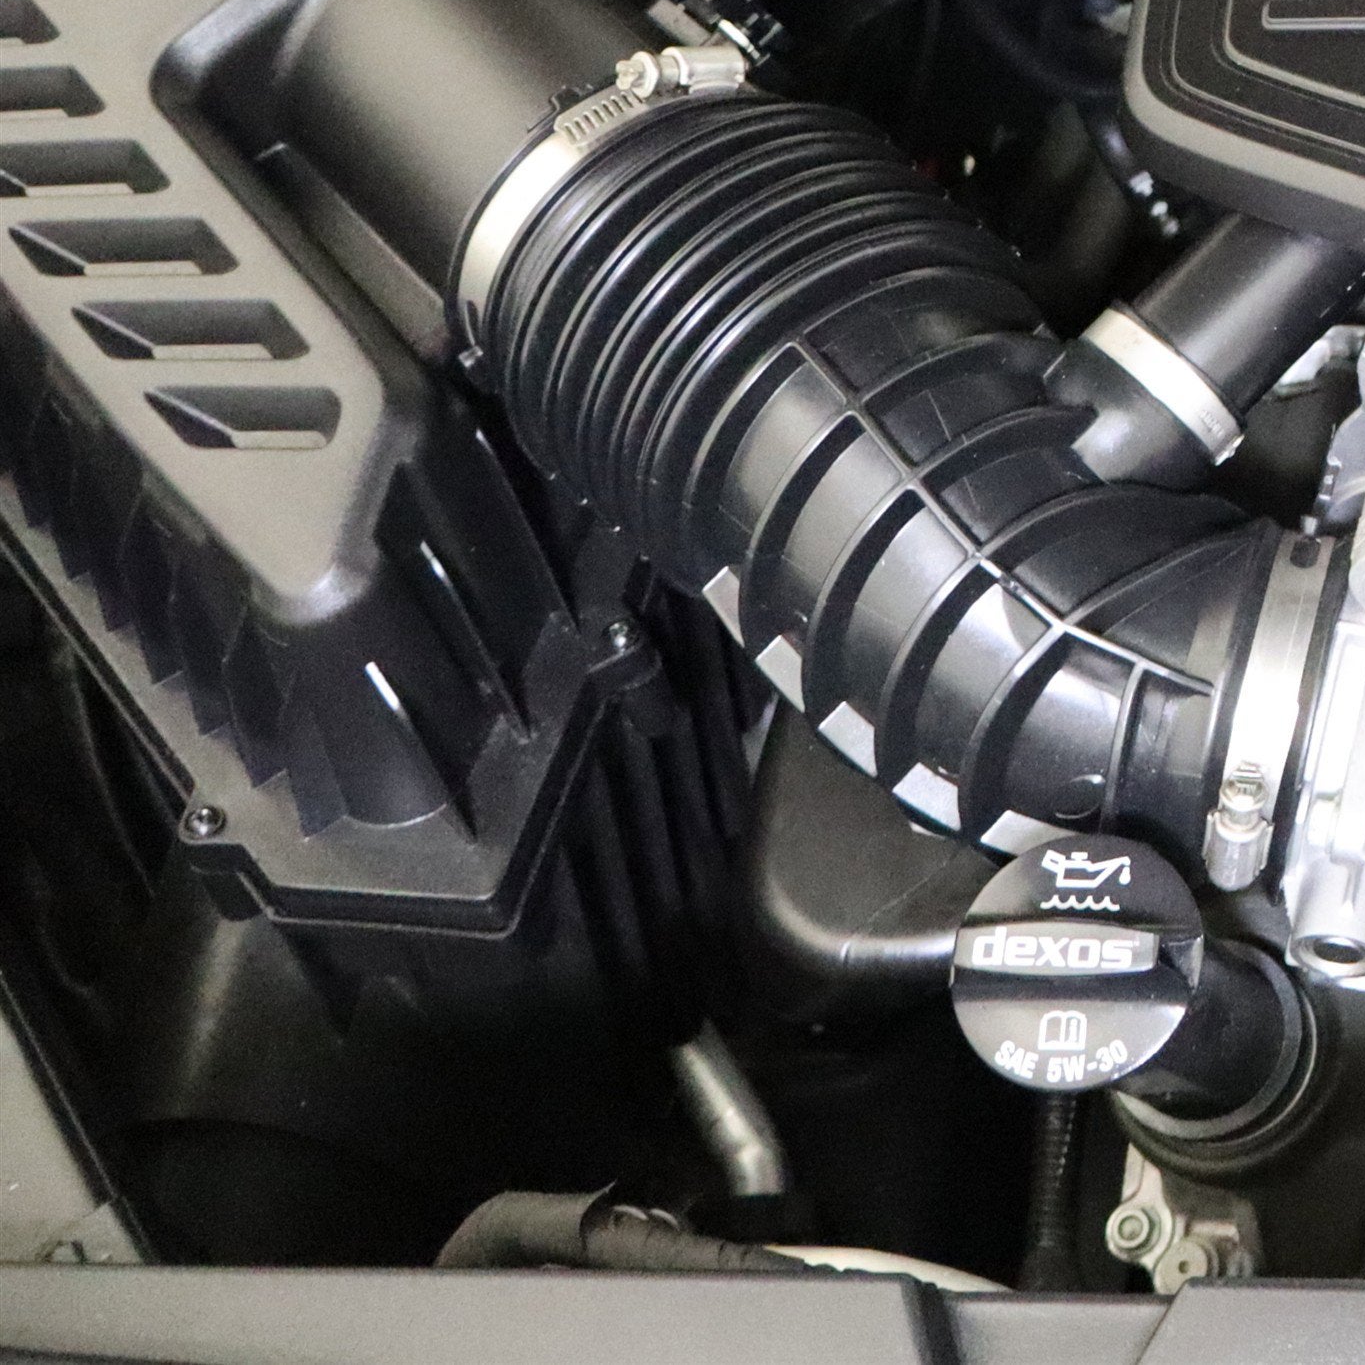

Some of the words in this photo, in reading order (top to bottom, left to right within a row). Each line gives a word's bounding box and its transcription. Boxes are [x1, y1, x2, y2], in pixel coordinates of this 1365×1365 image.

[971, 927, 1133, 968] dexos
[995, 1041, 1037, 1080] SAE
[1046, 1040, 1128, 1083] 5W-30
